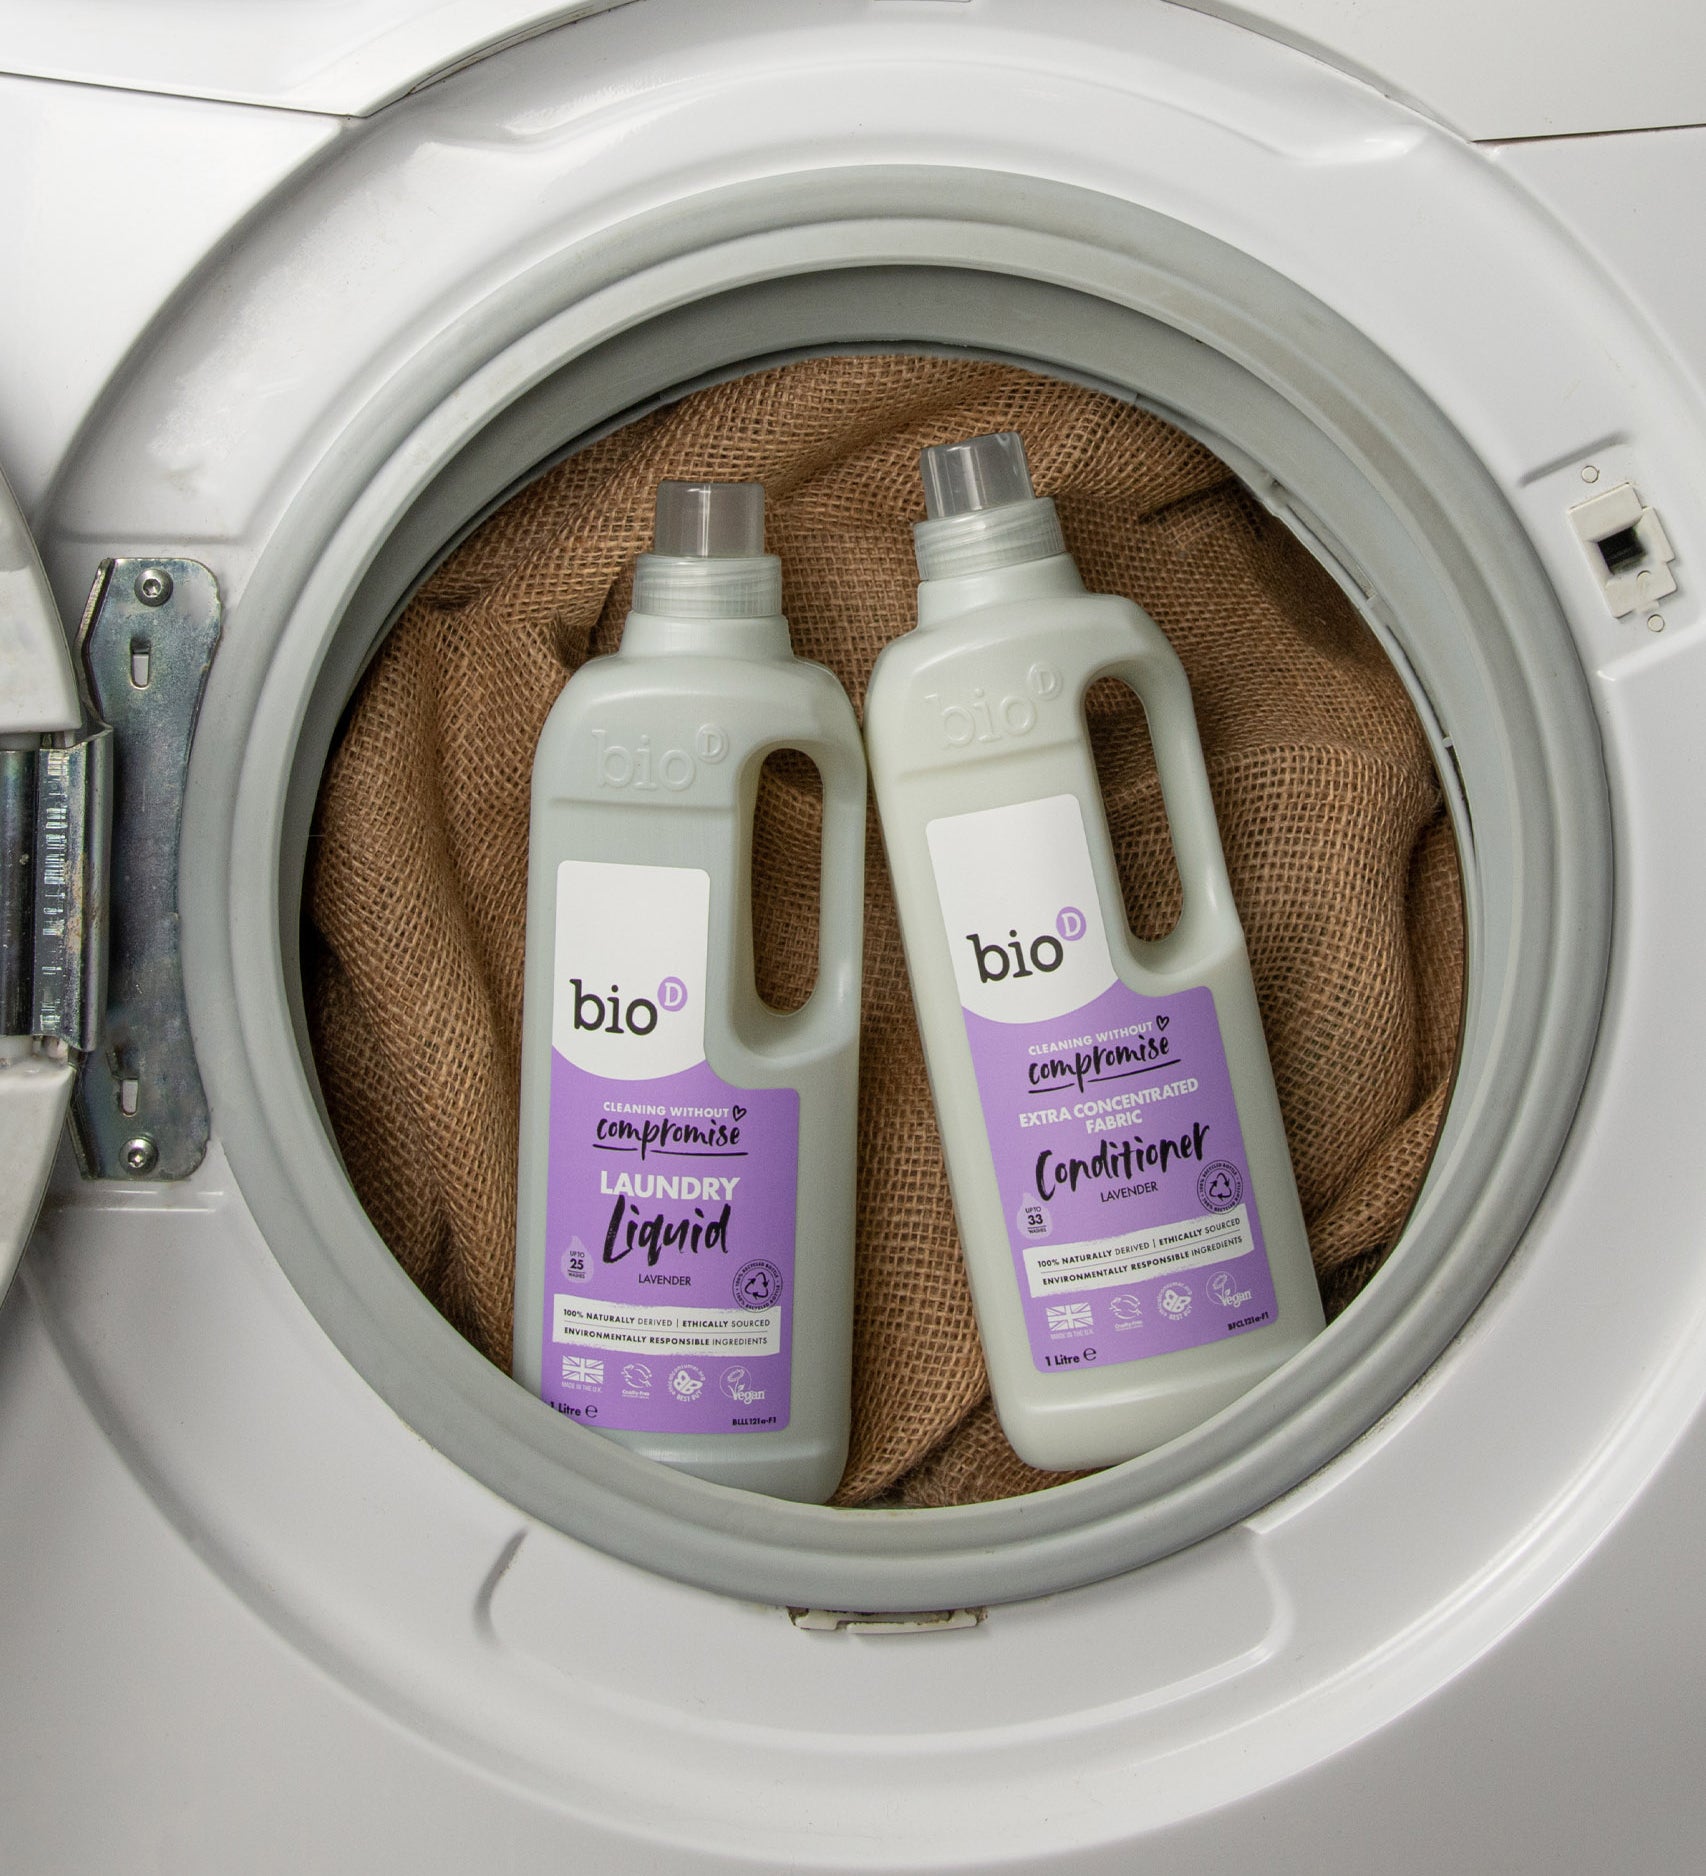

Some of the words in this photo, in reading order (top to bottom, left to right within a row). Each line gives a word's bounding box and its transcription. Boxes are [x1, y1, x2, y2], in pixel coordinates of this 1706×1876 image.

[1028, 1035, 1092, 1056] CLEANING
[1096, 1021, 1153, 1043] WITHOUT
[1028, 1035, 1169, 1093] compromise
[603, 1101, 666, 1116] CLEANING
[670, 1106, 729, 1118] WITHOUT
[1018, 1107, 1071, 1128] EXTRA
[1074, 1077, 1199, 1118] CONCENTRATED
[1086, 1110, 1142, 1134] FABRIC
[596, 1118, 740, 1161] compromise
[1036, 1122, 1210, 1201] Conditioner
[600, 1170, 741, 1201] LAUNDRY
[1100, 1181, 1158, 1202] LAVENDER
[1028, 1213, 1043, 1225] 33
[602, 1194, 731, 1266] Liquid
[1038, 1257, 1060, 1268] 100%
[1062, 1250, 1112, 1265] NATURALLY
[1115, 1242, 1150, 1256] DERIVED
[1159, 1228, 1203, 1246] ETHICALLY
[1205, 1217, 1241, 1234] SOURCED
[570, 1258, 584, 1270] 25
[1042, 1264, 1128, 1286] ENVIRONMENTALLY
[1130, 1251, 1190, 1271] RESPONSIBLE
[1191, 1235, 1243, 1259] INGREDIENTS
[638, 1273, 691, 1287] LAVENDER
[1214, 1290, 1252, 1308] Vegan
[563, 1308, 584, 1319] 100%
[586, 1311, 635, 1324] NATURALLY
[637, 1317, 673, 1327] DERIVED
[682, 1320, 729, 1328] ETHICALLY
[731, 1319, 770, 1328] SOURCED
[564, 1327, 647, 1344] ENVIRONMENTALLY
[649, 1336, 710, 1346] RESPONSIBLE
[712, 1337, 768, 1346] INGREDIENTS
[1045, 1355, 1051, 1367] 1
[1054, 1354, 1080, 1366] Litre
[728, 1385, 766, 1405] Vegan
[558, 1402, 581, 1417] Litre
